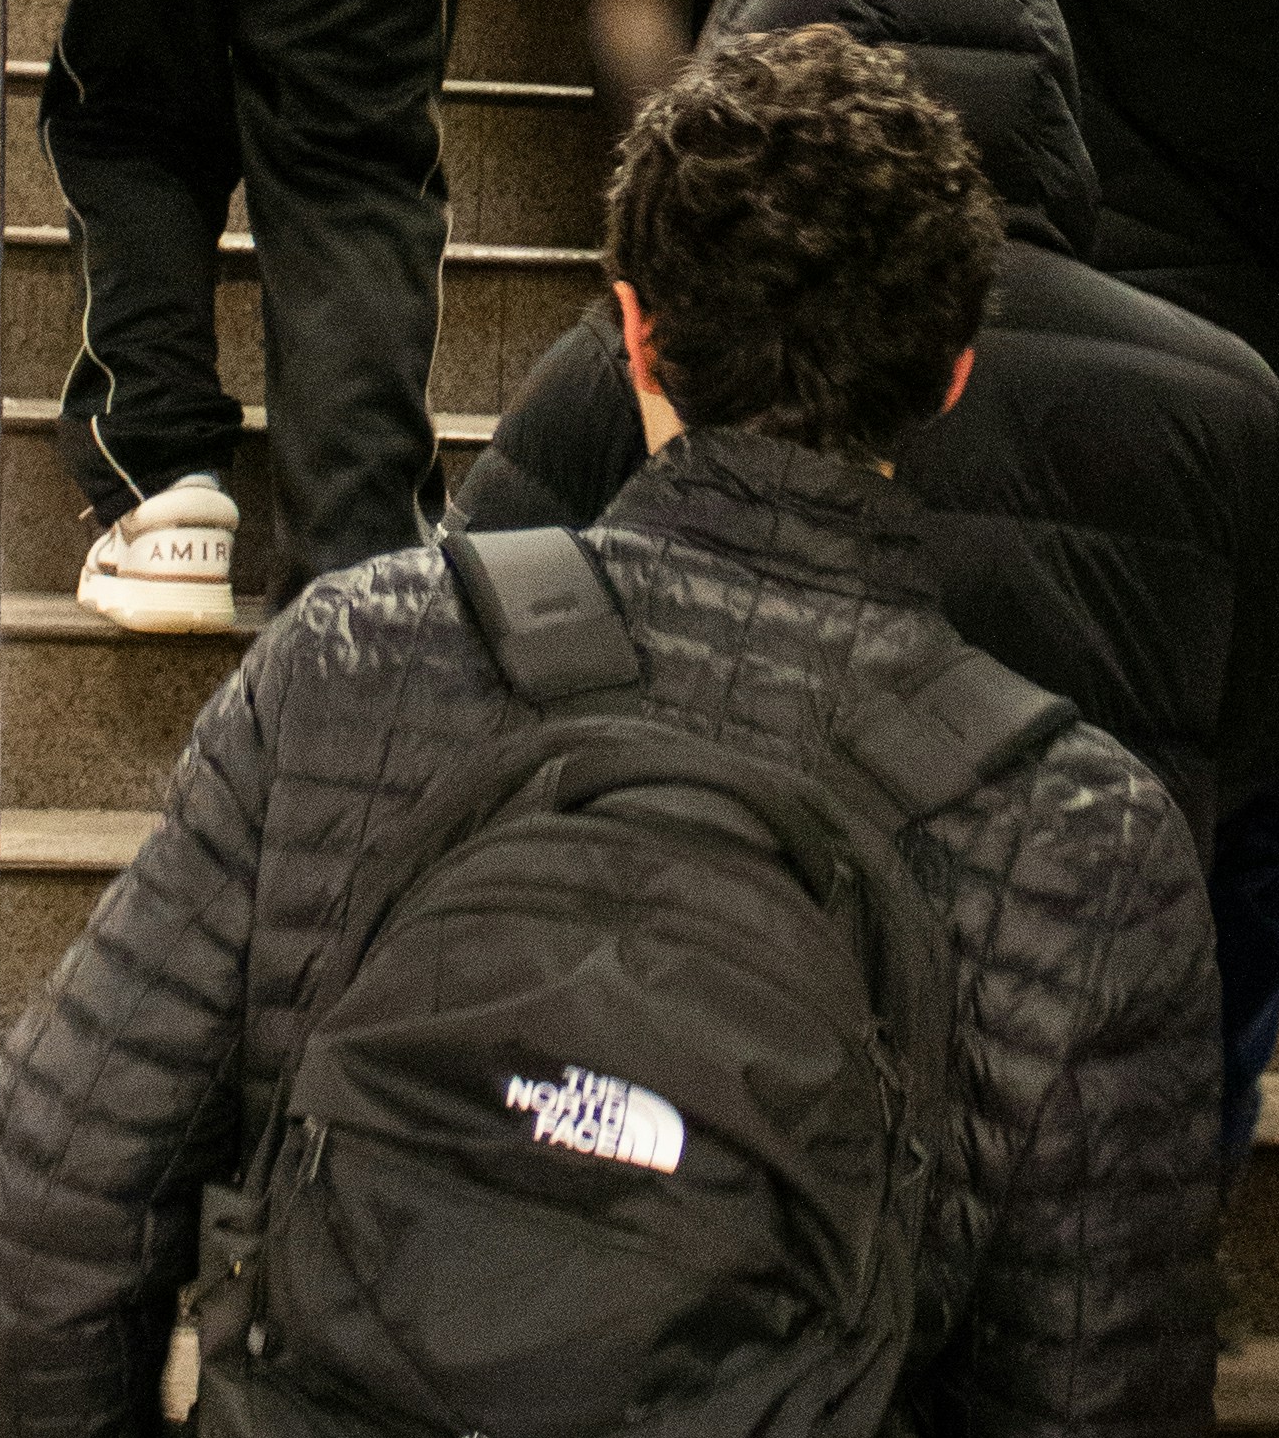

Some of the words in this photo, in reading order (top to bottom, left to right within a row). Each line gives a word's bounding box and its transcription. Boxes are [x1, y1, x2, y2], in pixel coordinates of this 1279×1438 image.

[506, 1075, 626, 1132] NORTH
[563, 1065, 629, 1103] THE
[531, 1108, 620, 1159] FACE
